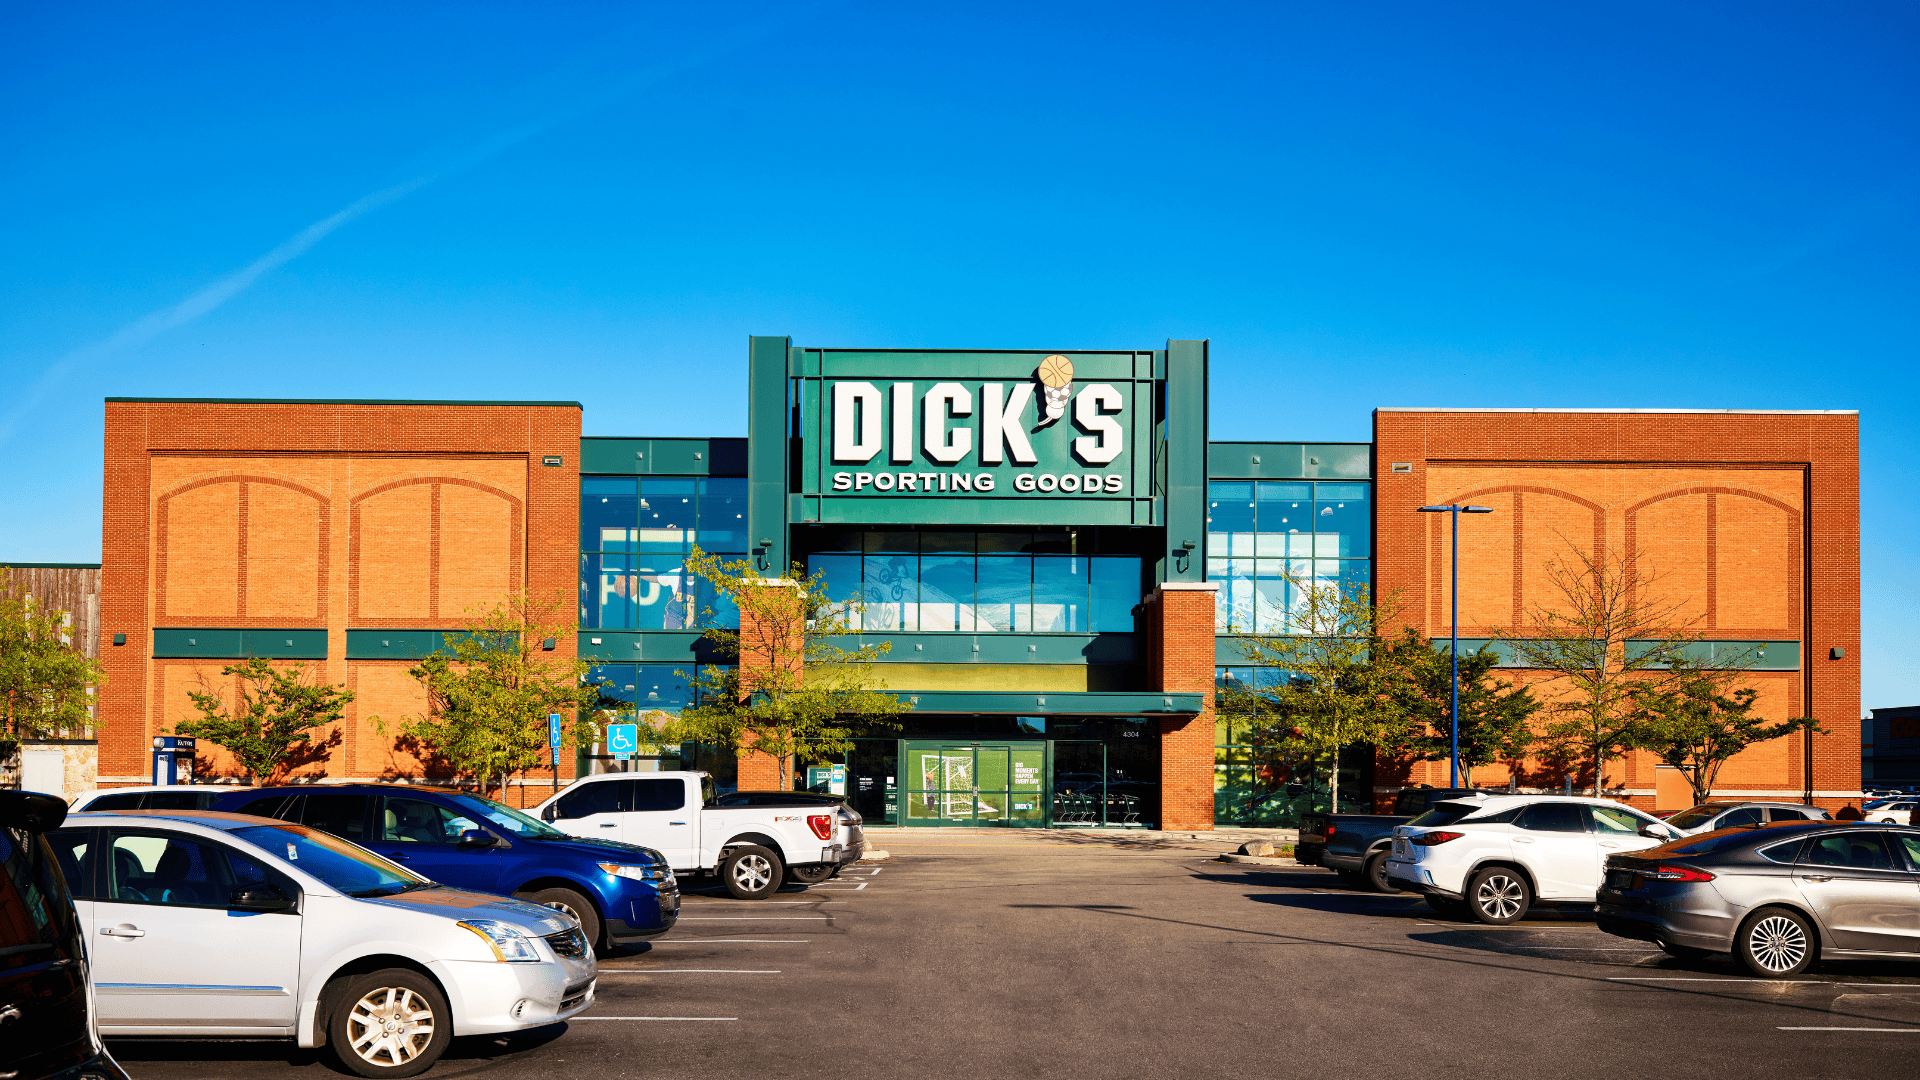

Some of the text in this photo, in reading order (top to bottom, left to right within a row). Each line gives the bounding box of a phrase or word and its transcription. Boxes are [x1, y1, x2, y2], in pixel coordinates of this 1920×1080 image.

[832, 355, 1123, 463] DICK'S
[833, 472, 1123, 492] SPORTING GOODS
